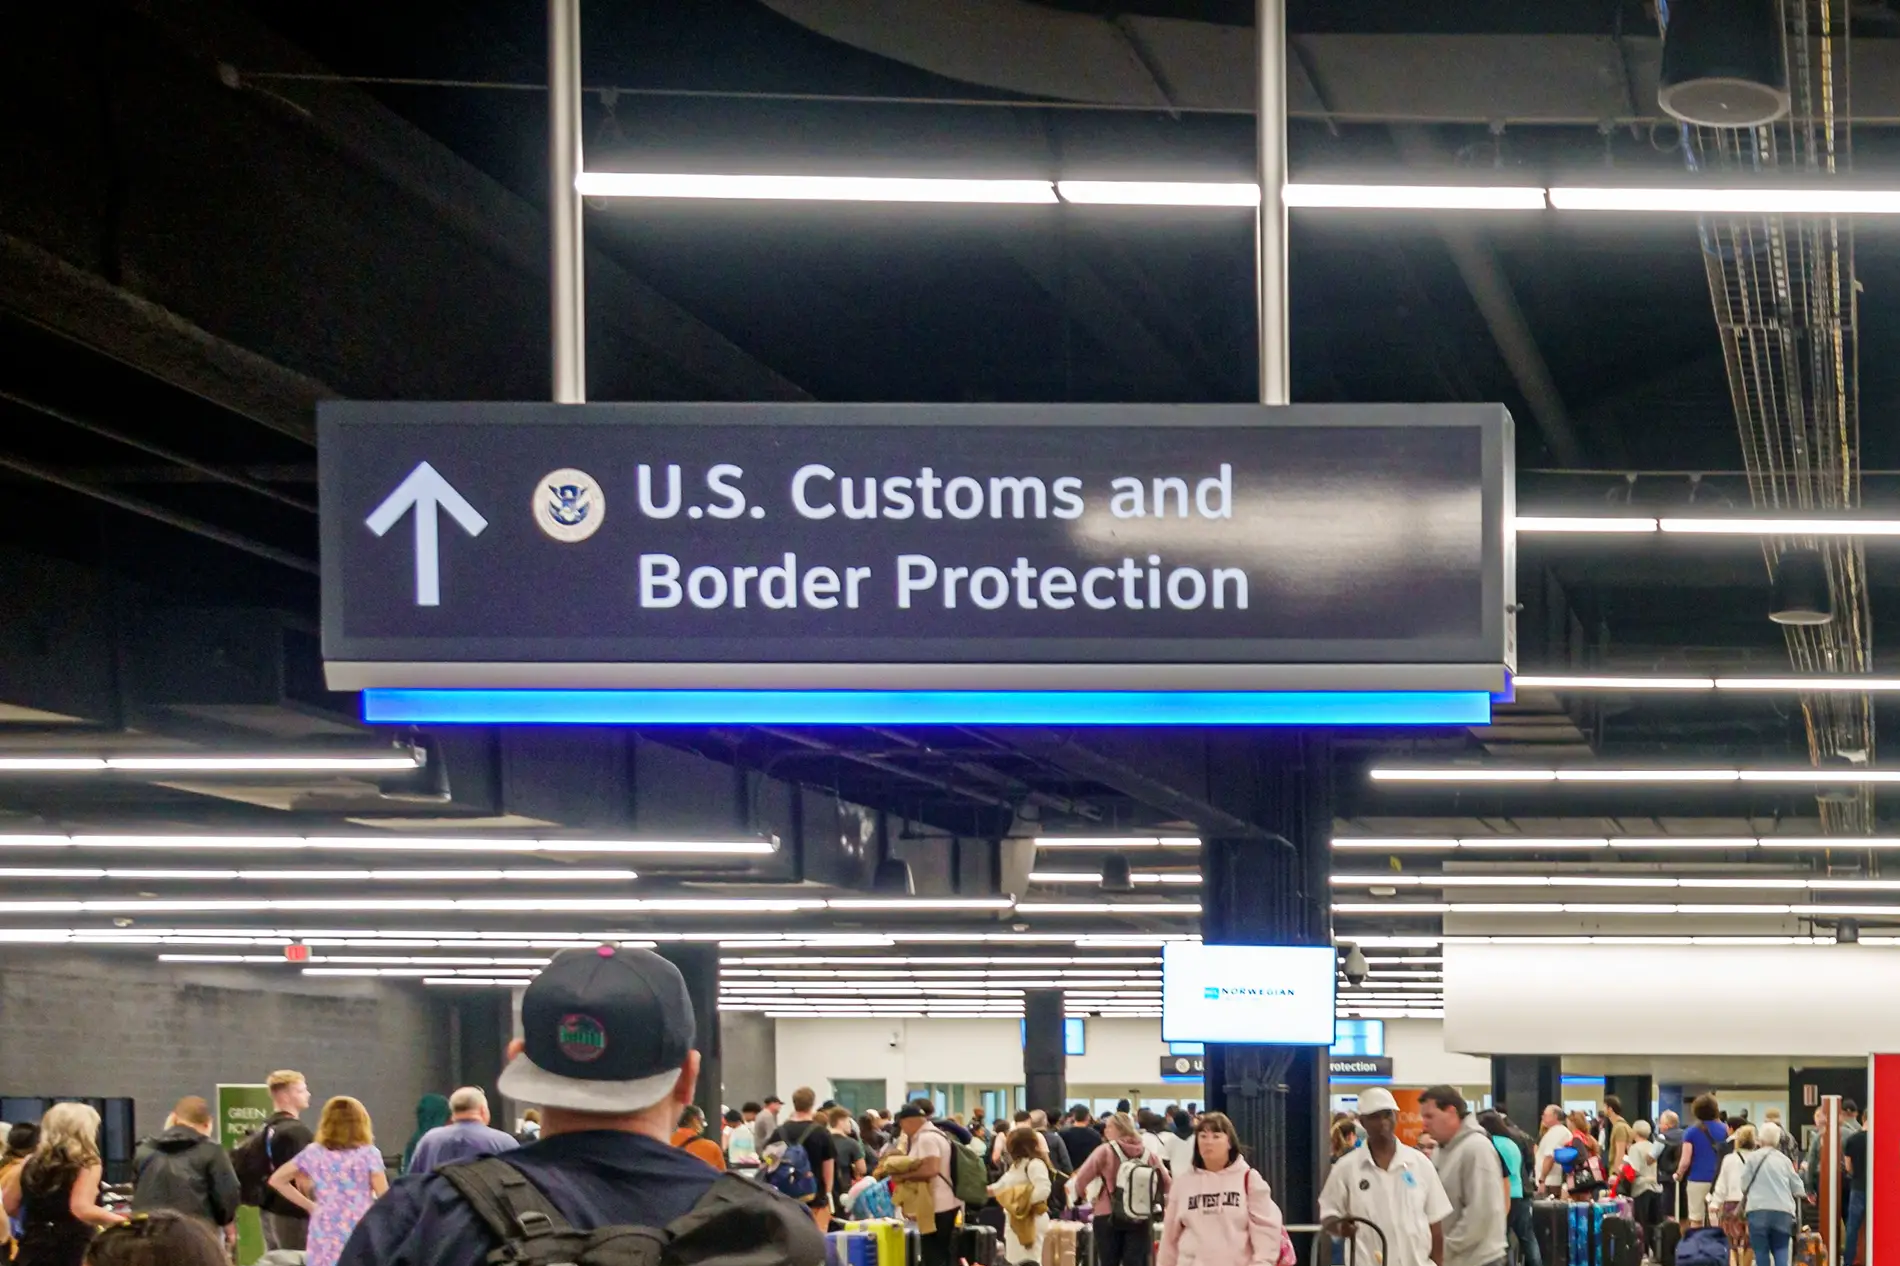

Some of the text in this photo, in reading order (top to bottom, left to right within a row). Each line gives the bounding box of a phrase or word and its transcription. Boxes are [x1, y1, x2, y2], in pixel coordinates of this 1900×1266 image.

[638, 464, 766, 520] U.S.
[790, 464, 1085, 521] Customs
[1109, 464, 1233, 522] and
[640, 552, 1250, 611] Border Protection
[1221, 987, 1295, 996] NORWEGIAN
[1330, 1061, 1377, 1072] rotection
[227, 1107, 267, 1119] GREEN
